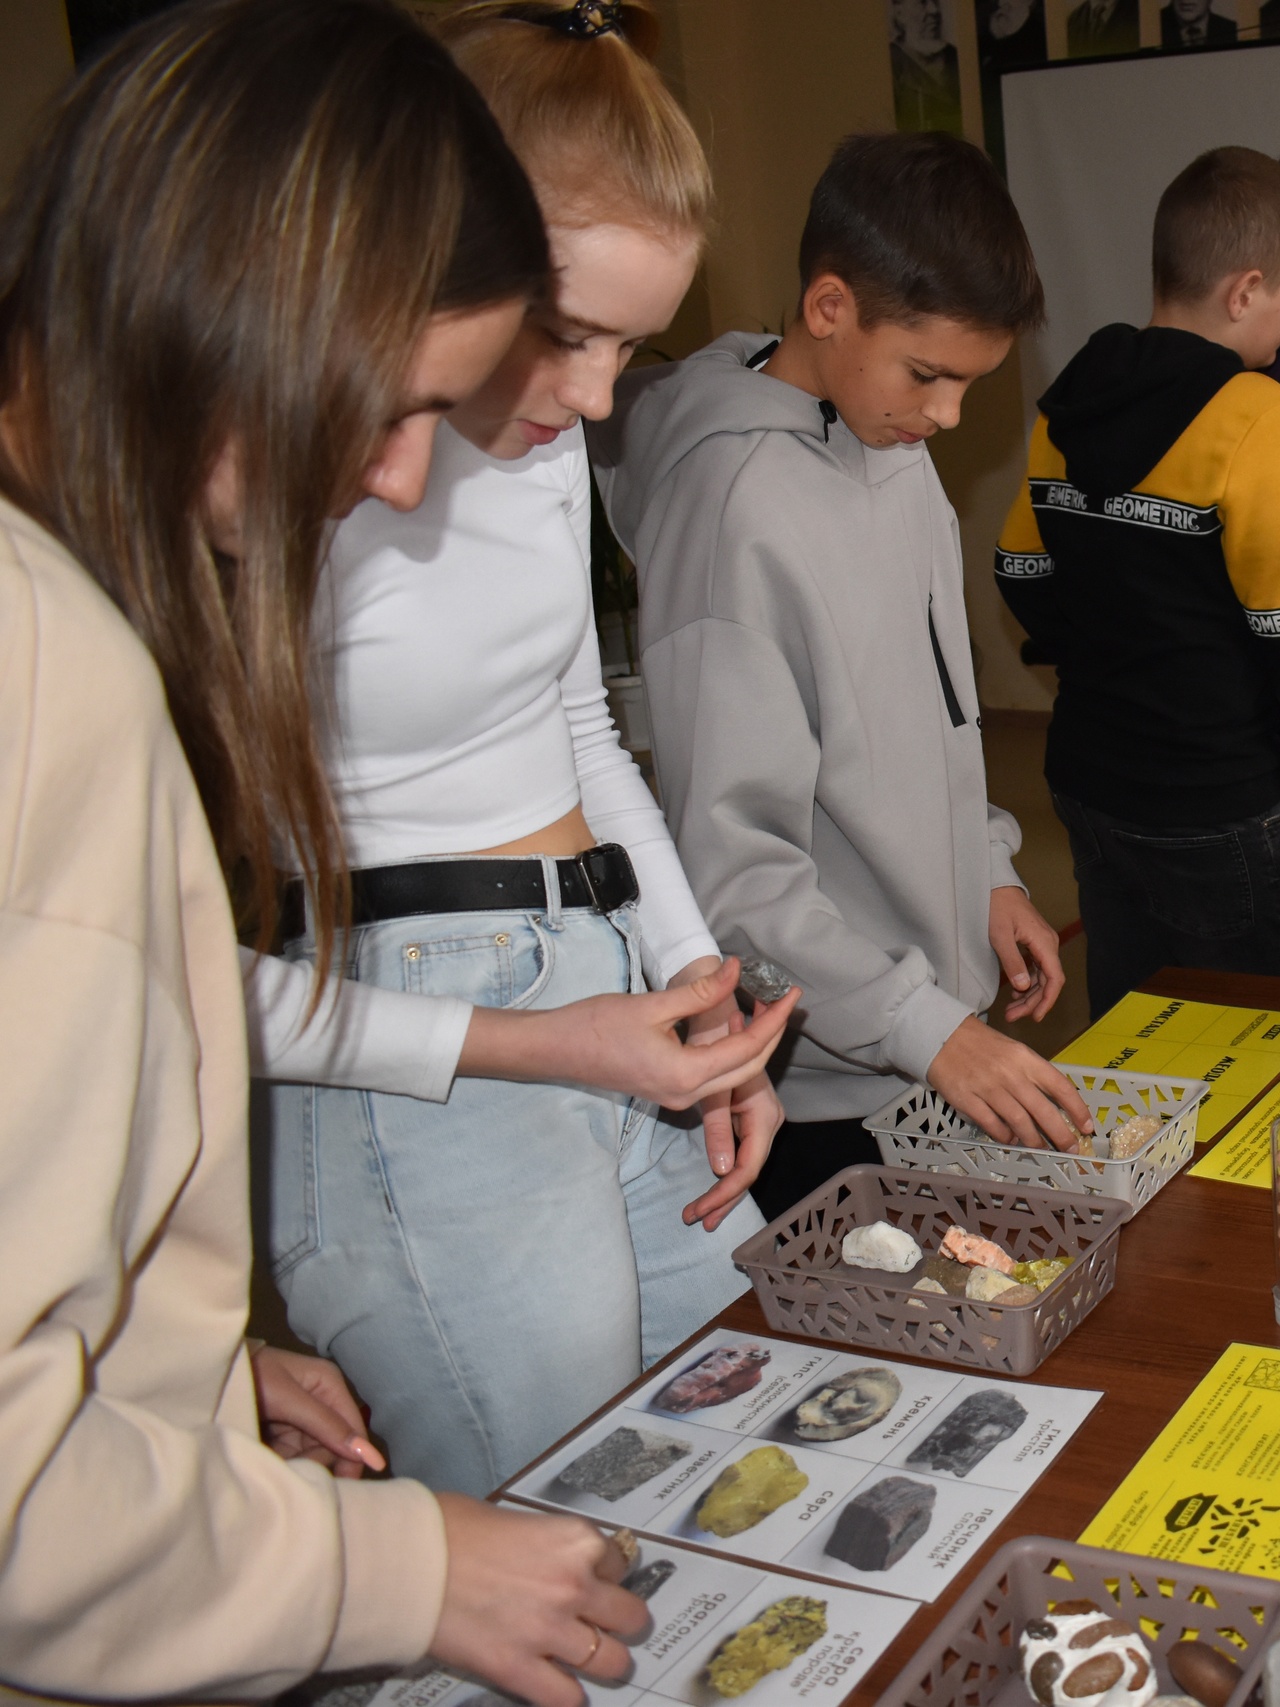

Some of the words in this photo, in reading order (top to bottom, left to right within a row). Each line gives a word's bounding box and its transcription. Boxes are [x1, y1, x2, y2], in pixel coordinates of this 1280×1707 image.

[1103, 496, 1200, 531] GEOMETRIC
[1003, 556, 1055, 575] GEOM
[1136, 1001, 1185, 1038] КРИСТАЛЛ
[1201, 1056, 1238, 1082] ЖЕОДА
[793, 1356, 822, 1379] гипс
[882, 1395, 932, 1440] кремень
[1013, 1419, 1054, 1463] кристалл
[1034, 1428, 1061, 1456] гипс
[654, 1450, 716, 1501] известняк
[799, 1490, 834, 1521] сера
[933, 1507, 994, 1570] песчаник
[652, 1592, 727, 1660] арагонит
[824, 1646, 864, 1687] сера
